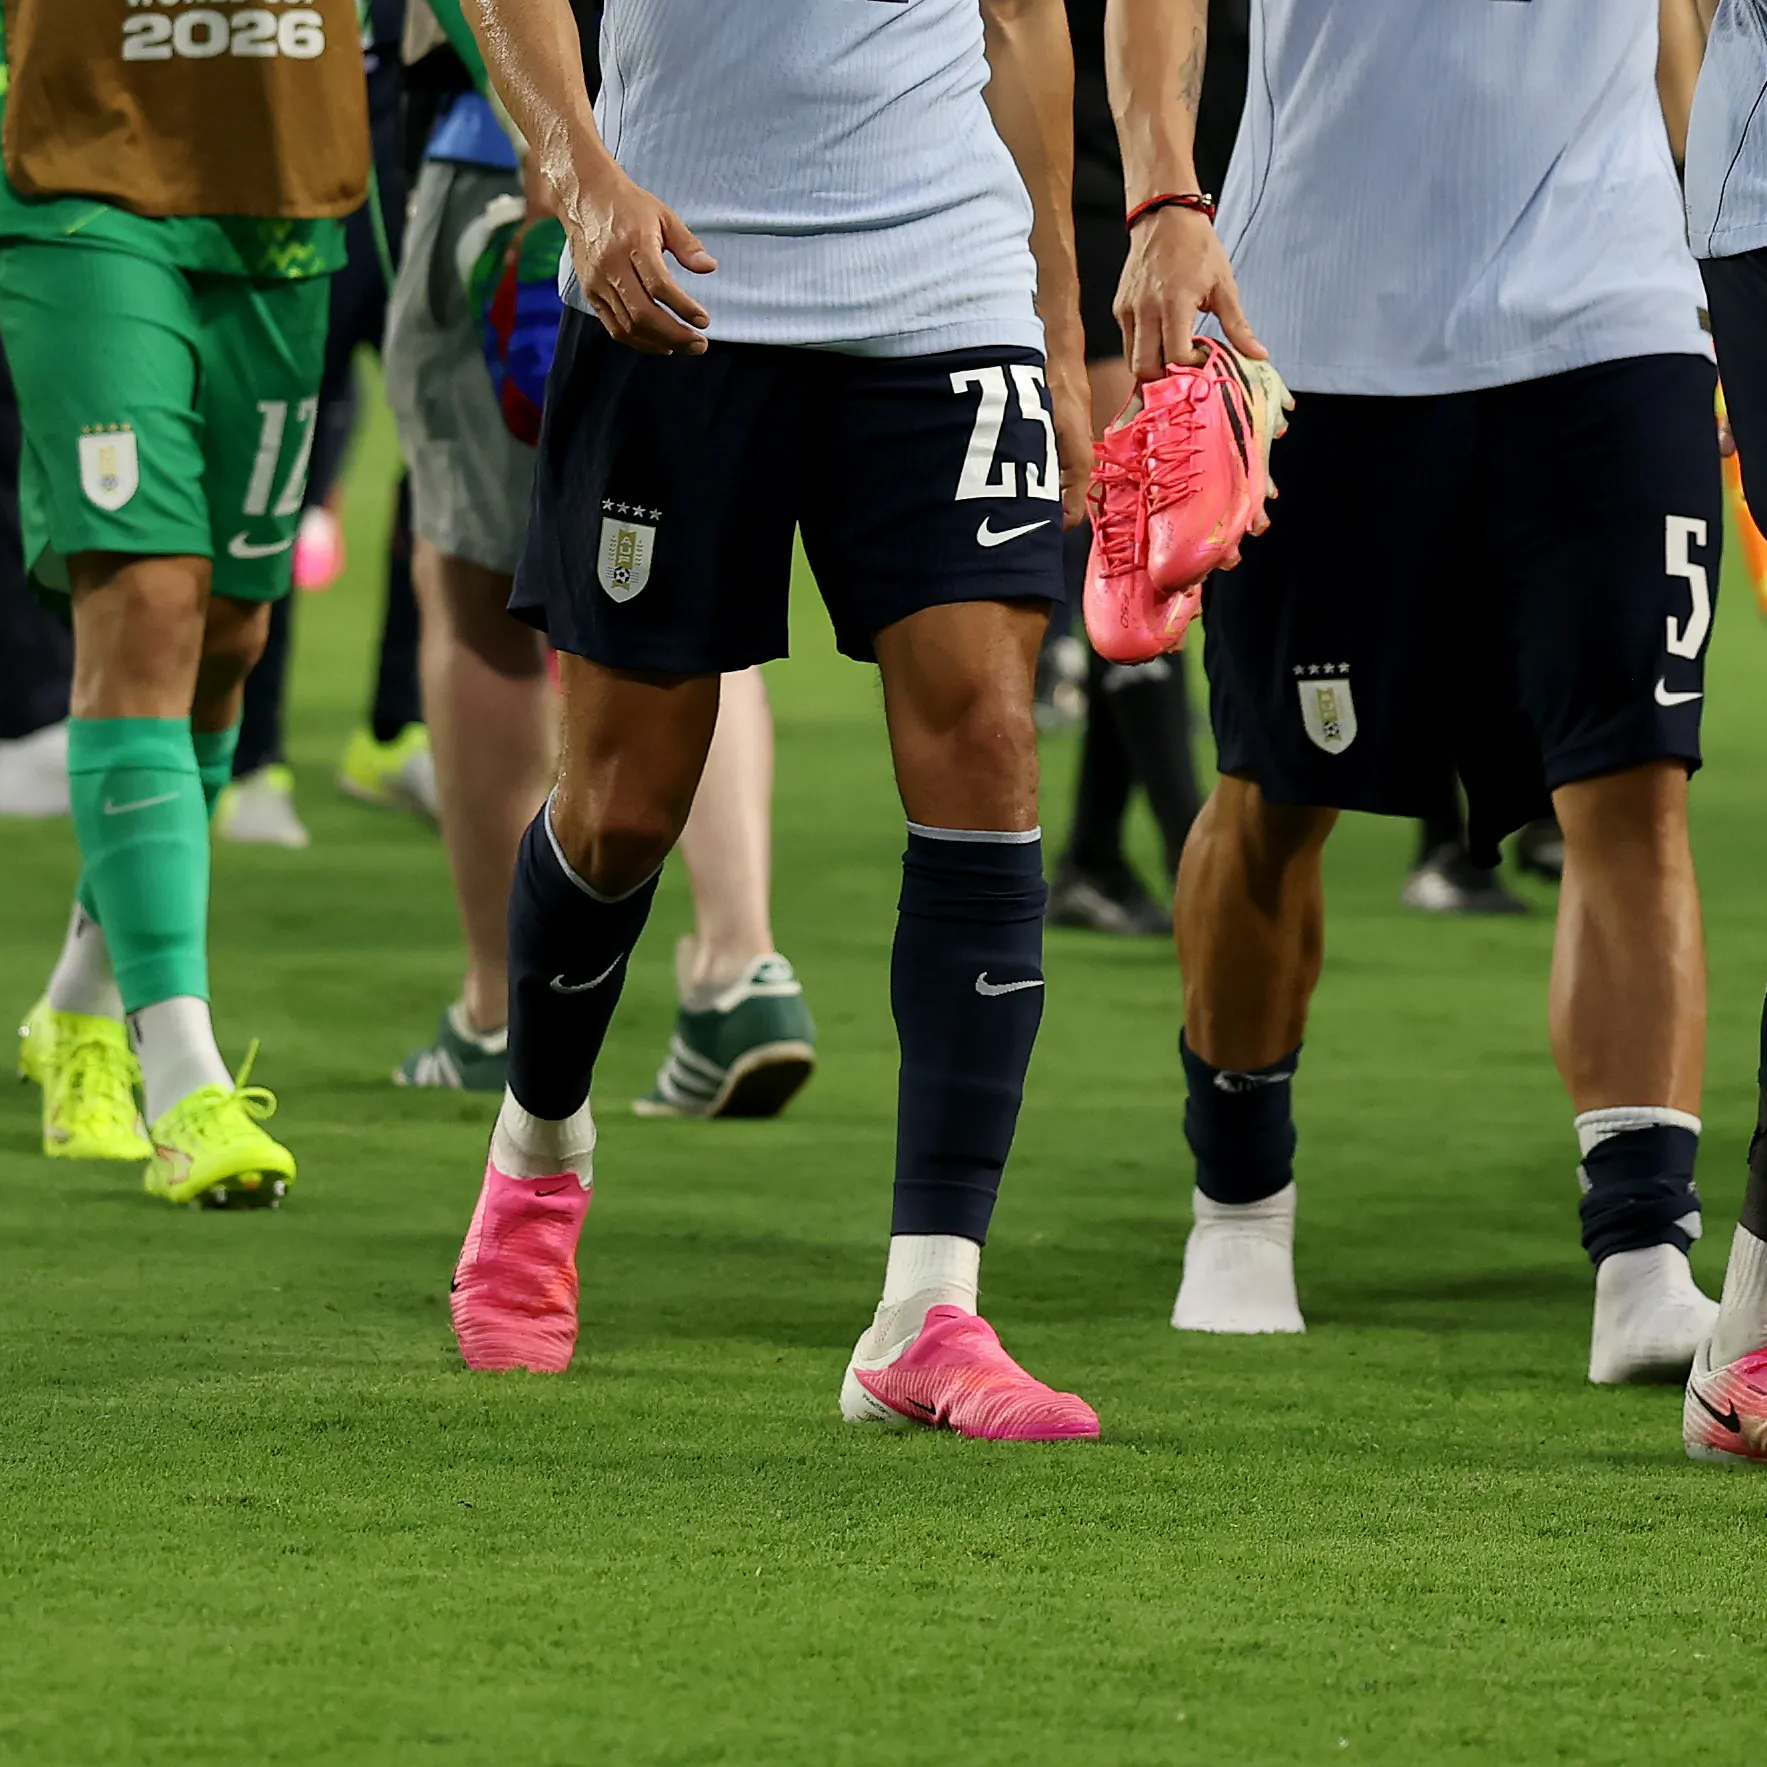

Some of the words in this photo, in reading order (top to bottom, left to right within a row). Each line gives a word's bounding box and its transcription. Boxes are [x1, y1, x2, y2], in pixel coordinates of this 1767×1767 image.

[121, 8, 326, 61] 2026
[949, 364, 1061, 502] 25
[1663, 514, 1711, 661] 5
